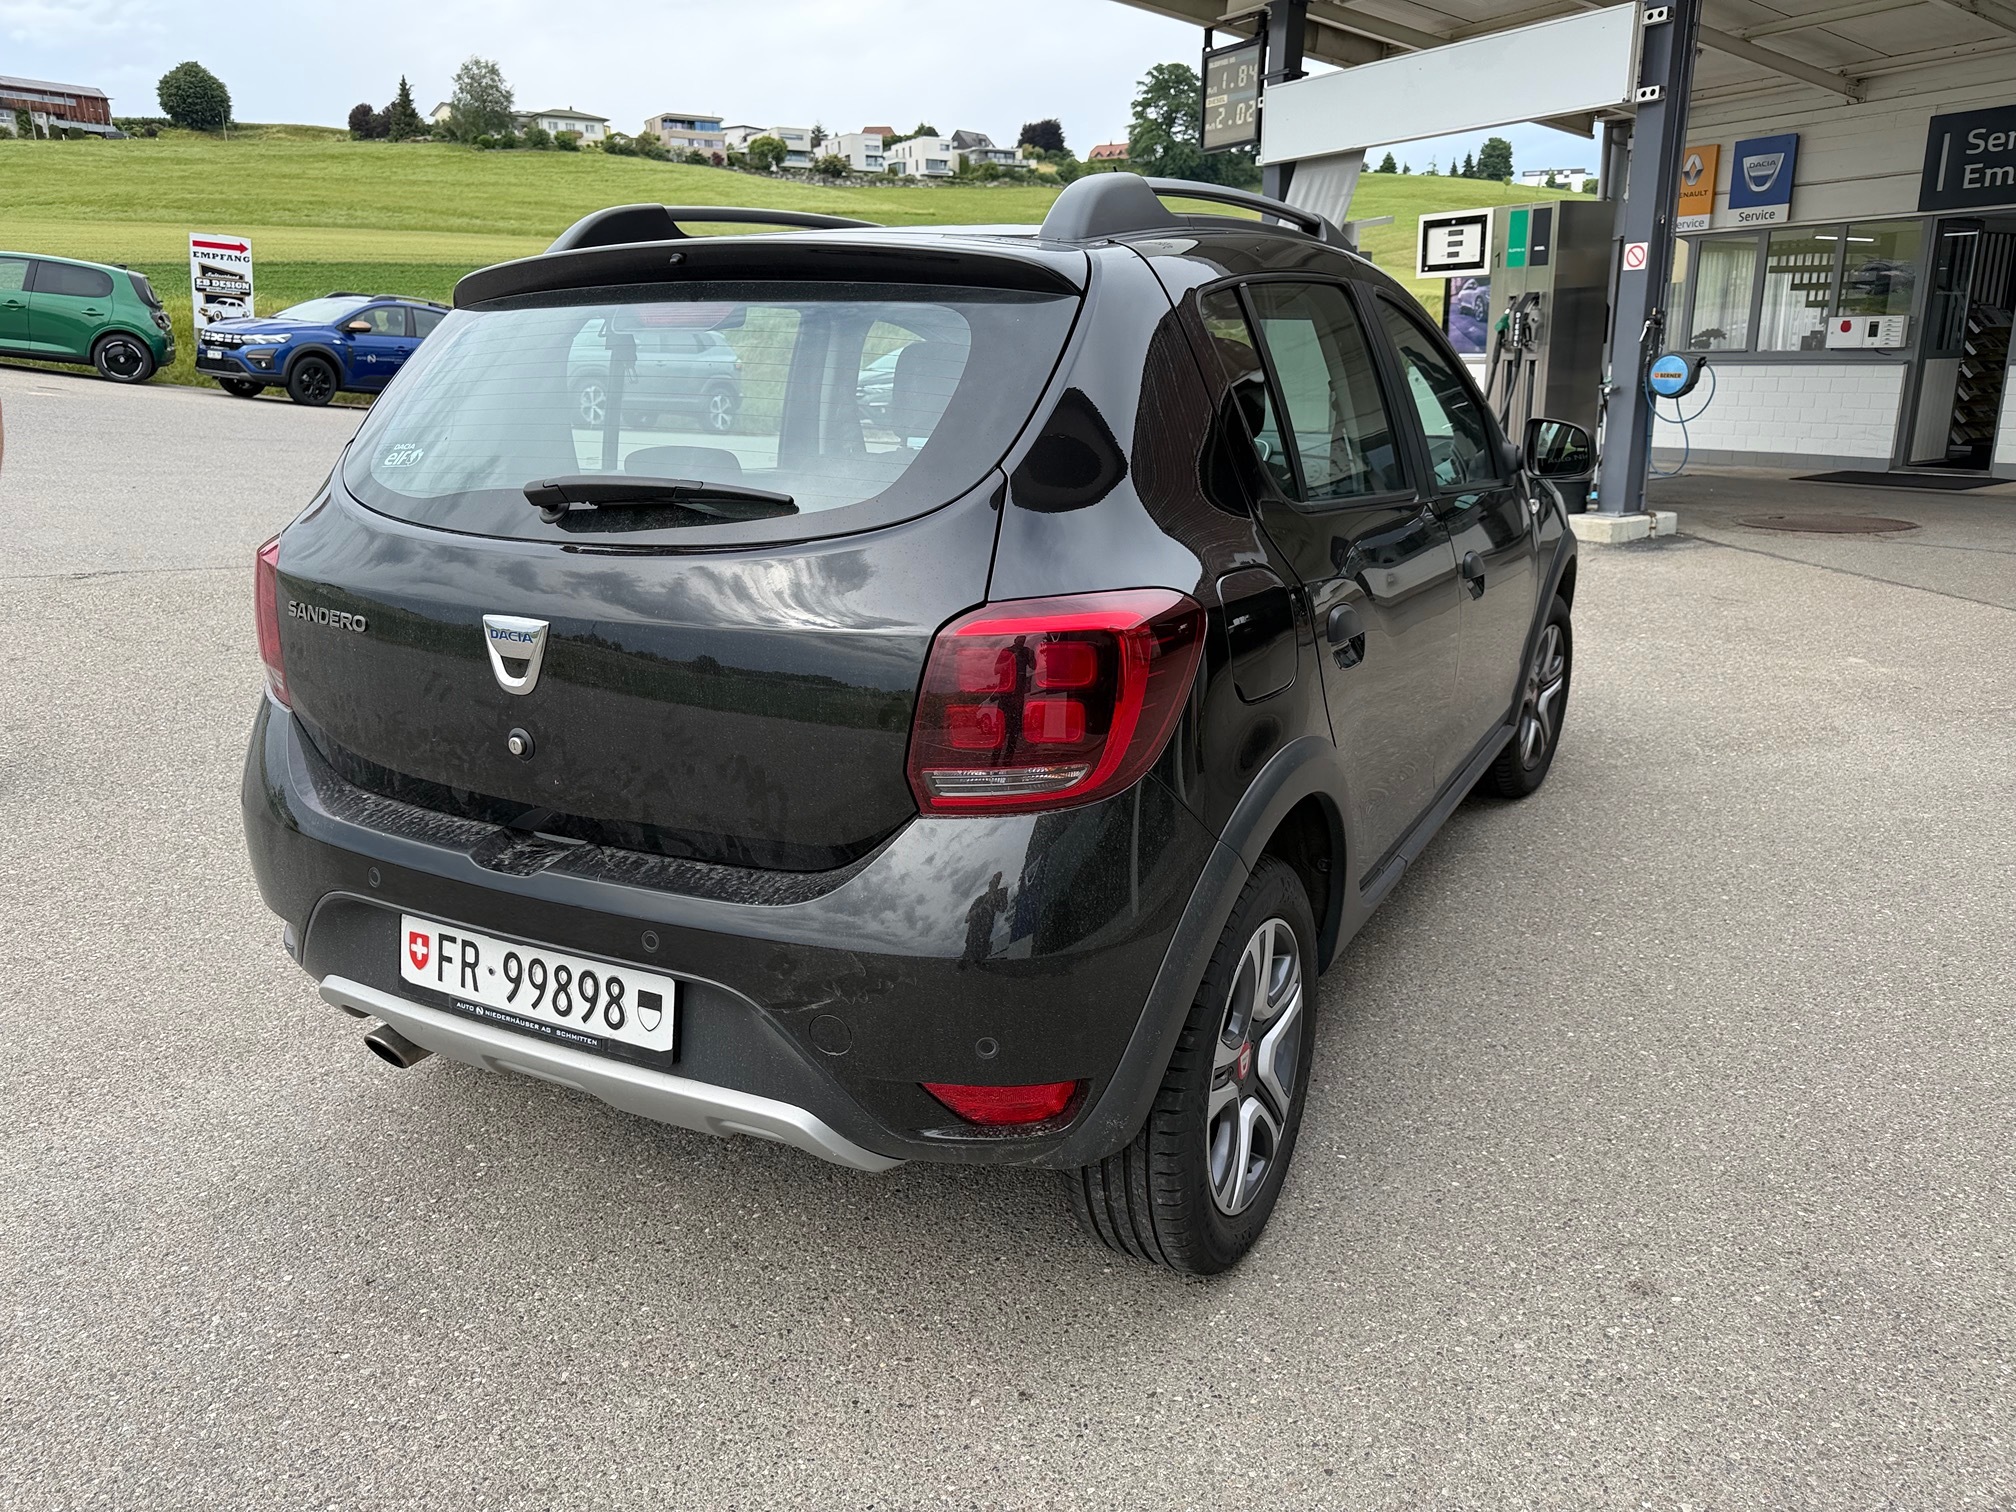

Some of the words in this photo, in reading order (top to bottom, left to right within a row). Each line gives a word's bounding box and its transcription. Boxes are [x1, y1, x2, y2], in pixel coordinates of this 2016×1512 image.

[1222, 64, 1257, 89] 1.84
[1216, 101, 1256, 129] 2.02
[1749, 160, 1777, 169] DACIA
[1963, 163, 2015, 189] Em
[1680, 190, 1709, 198] ENAULT
[1738, 209, 1776, 222] Service
[1677, 218, 1705, 229] ervice
[193, 251, 250, 263] EMPFANG
[196, 278, 211, 286] EB
[211, 280, 250, 290] DESIGN
[384, 451, 412, 465] elf
[288, 600, 366, 632] SANDERO
[490, 629, 533, 643] DACIA
[437, 933, 480, 993] FR
[503, 951, 626, 1031] 99898
[456, 1001, 475, 1012] AUTO
[485, 1010, 540, 1031] NIEDERHÄUSER
[556, 1029, 598, 1046] SCHMITTEN
